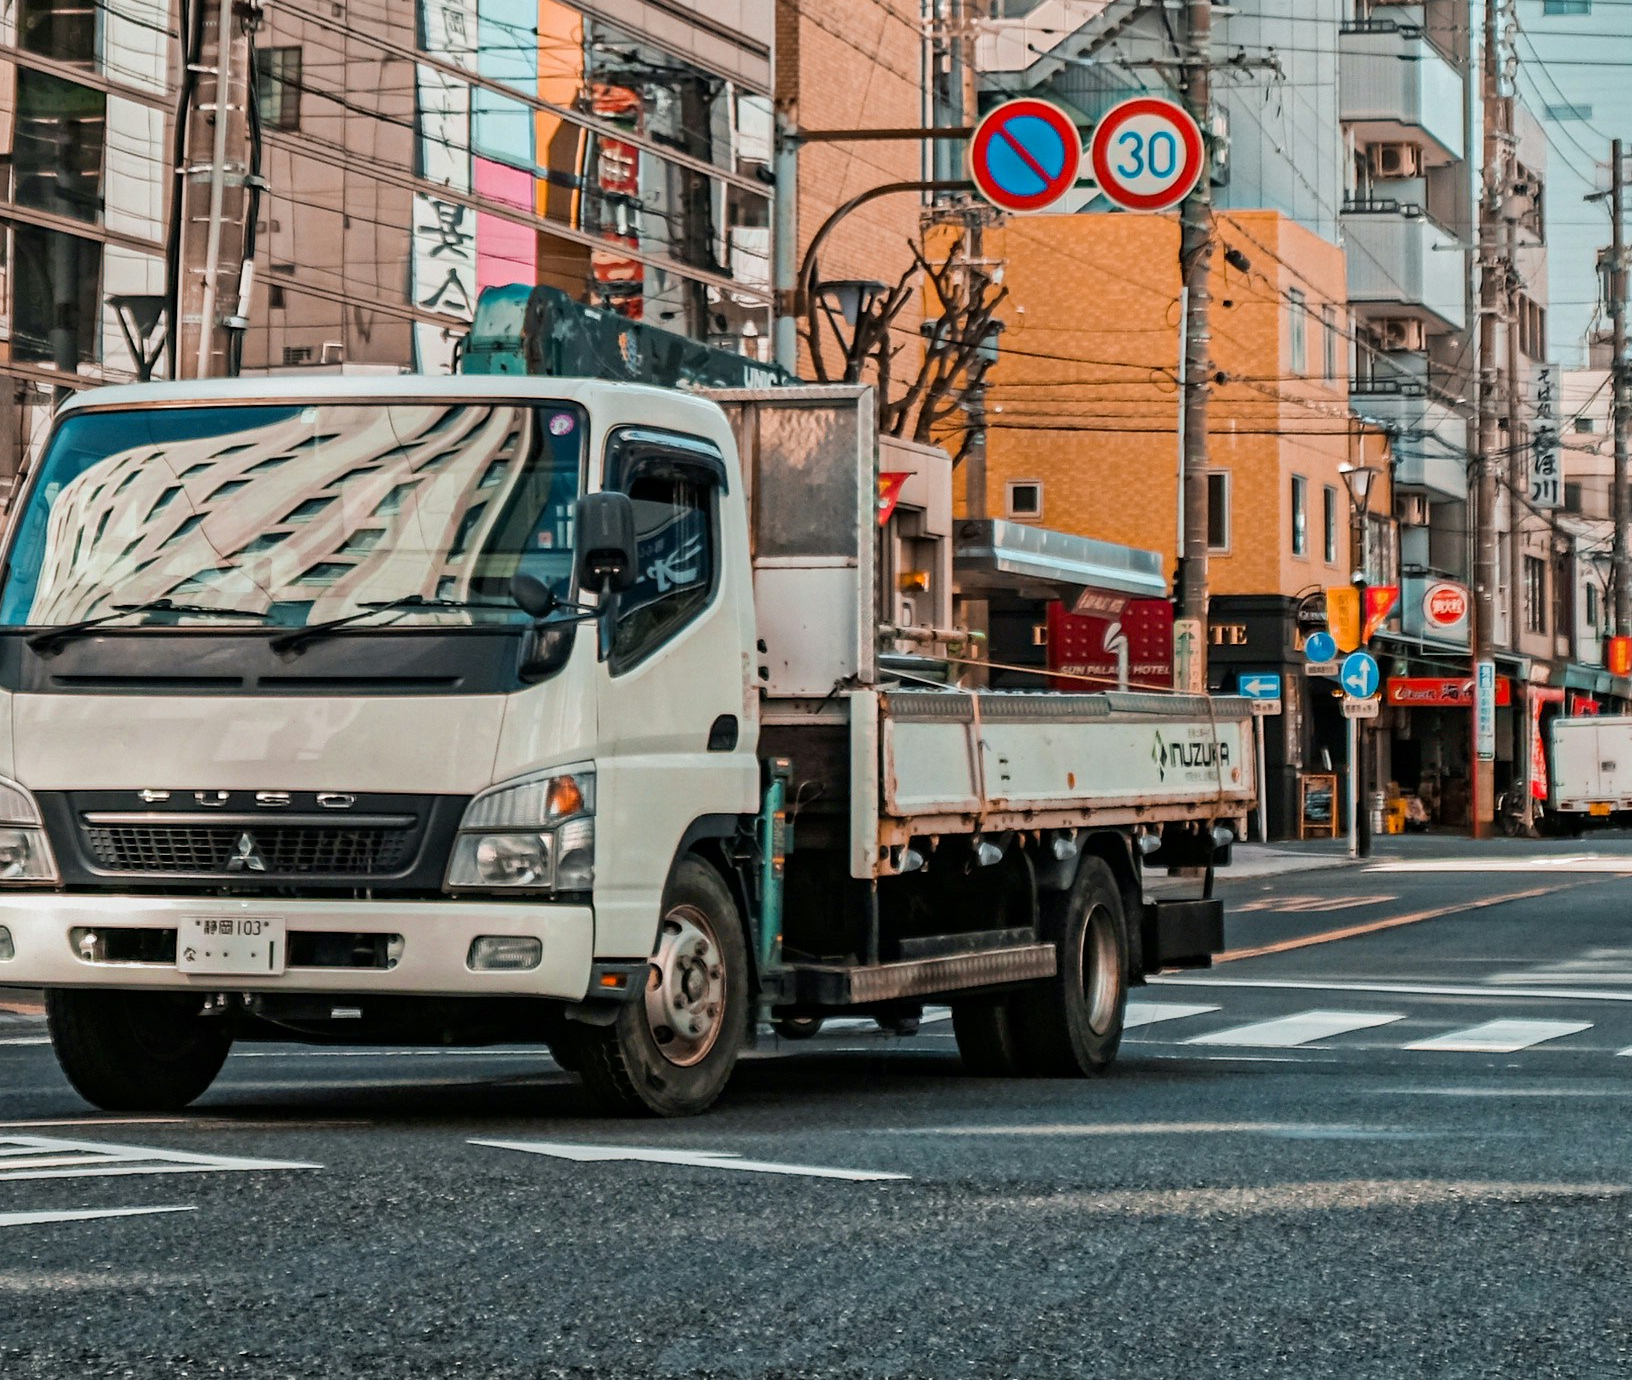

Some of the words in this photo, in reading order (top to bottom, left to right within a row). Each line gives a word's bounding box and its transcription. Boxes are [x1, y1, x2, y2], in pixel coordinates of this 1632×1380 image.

[1116, 131, 1177, 179] 30
[1537, 369, 1556, 420] そば処
[1133, 665, 1171, 676] HOTEL
[137, 788, 357, 809] FUSO
[204, 919, 262, 936] 静岡103
